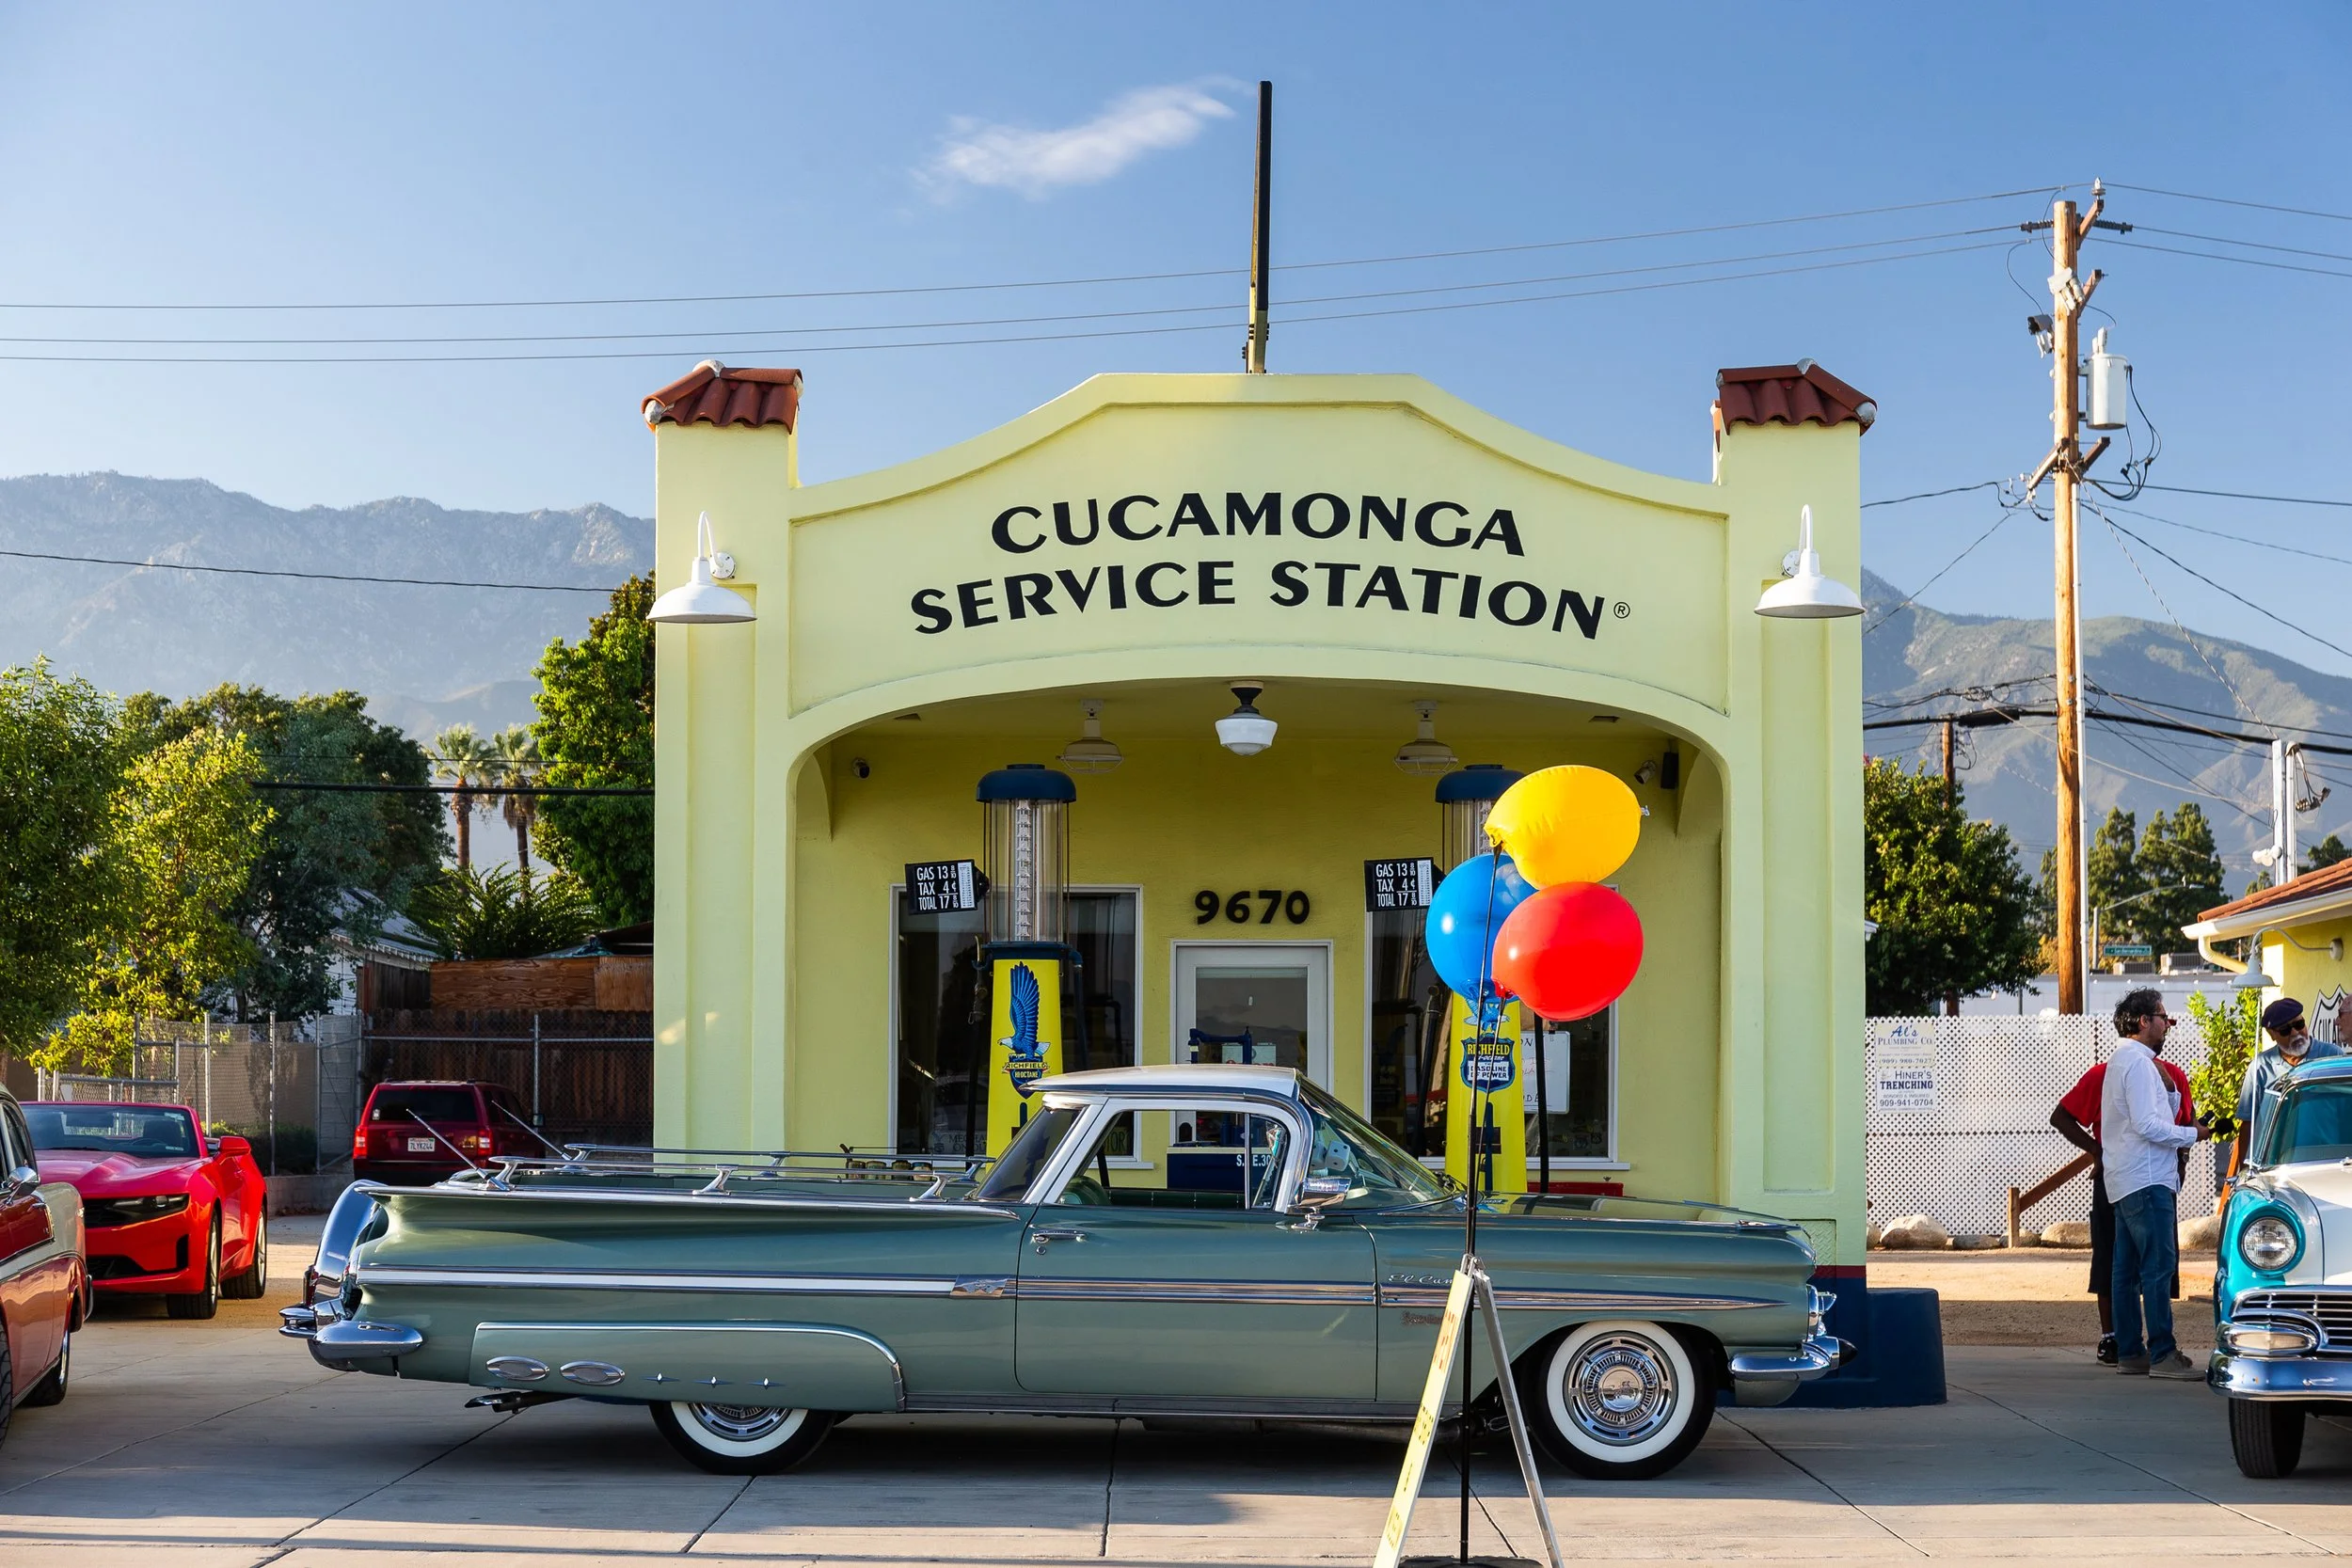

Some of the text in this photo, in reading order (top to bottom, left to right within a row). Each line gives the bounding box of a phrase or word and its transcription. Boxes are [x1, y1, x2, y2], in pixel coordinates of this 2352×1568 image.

[991, 491, 1525, 557] CUCAMONGA
[910, 561, 1235, 635] SERVICE
[916, 866, 934, 880] GAS
[937, 865, 948, 879] 13
[1375, 863, 1393, 878] GAS
[1396, 863, 1407, 877] 13
[917, 881, 935, 895] TAX
[1376, 879, 1394, 893] TAX
[918, 896, 937, 911] TOTAL
[939, 895, 949, 909] 17
[1376, 894, 1395, 907] TOTAL
[1398, 893, 1408, 906] 17
[1195, 890, 1310, 925] 9670
[1891, 1024, 1918, 1037] Al's
[1467, 1043, 1510, 1054] RIHFELD
[1895, 1070, 1931, 1079] HINER'S
[1880, 1080, 1933, 1089] TRENCHING
